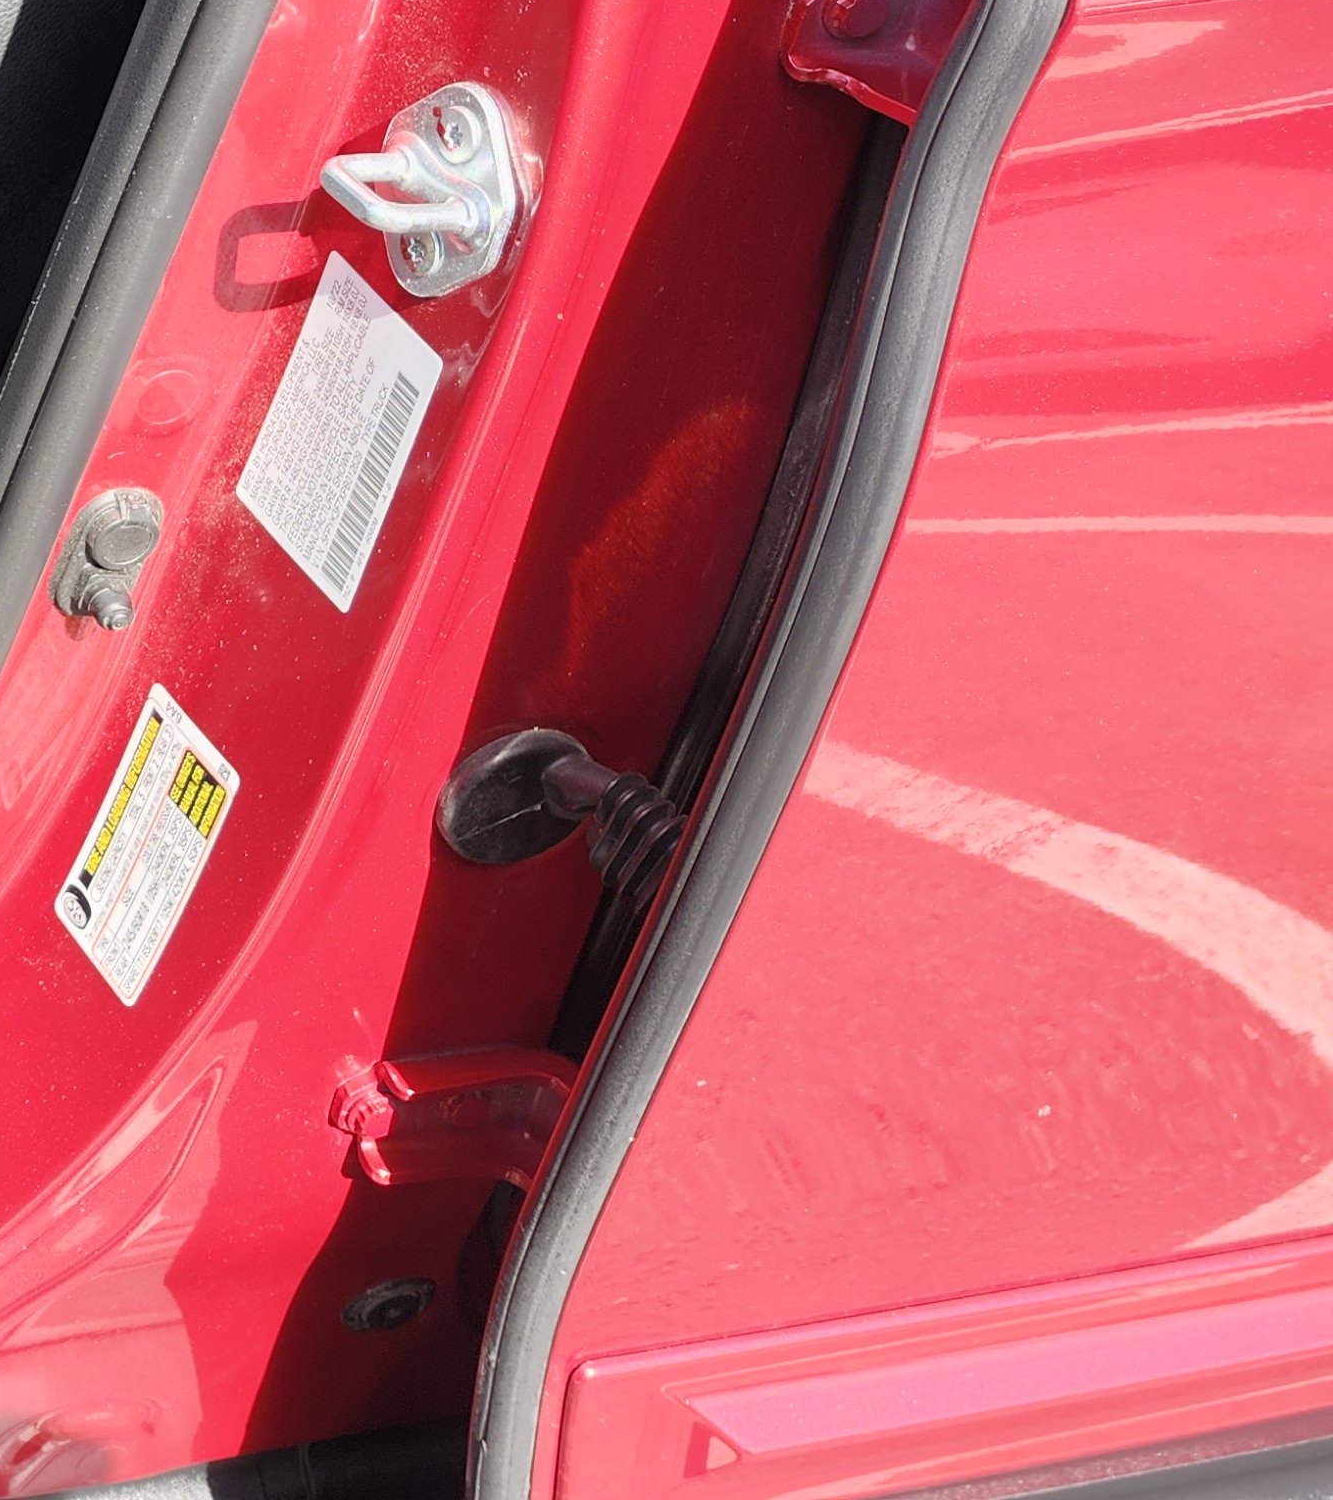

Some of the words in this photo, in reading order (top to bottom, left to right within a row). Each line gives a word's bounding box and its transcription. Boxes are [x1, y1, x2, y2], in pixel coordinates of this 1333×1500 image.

[320, 325, 335, 353] SIZE
[248, 417, 287, 503] MANUFACTURING
[307, 336, 320, 360] LLC
[257, 415, 277, 455] HONDA
[271, 345, 306, 421] DEVELOPMENT
[279, 508, 294, 536] THIS
[288, 465, 311, 512] VEHICLE
[305, 408, 334, 470] CONFORMS
[334, 373, 348, 397] ALL
[341, 311, 372, 378] APPLICABLE
[370, 380, 389, 420] TRUCK
[256, 474, 274, 510] GVWR
[263, 483, 281, 519] GAWR
[271, 491, 289, 527] GAWR
[286, 495, 310, 545] FEDERAL
[304, 458, 325, 500] MOTOR
[319, 414, 342, 463] VEHICLE
[336, 374, 358, 419] SAFETY
[294, 489, 323, 553] STANDARDS
[322, 438, 344, 482] EFFECT
[345, 399, 359, 426] THE
[353, 371, 370, 404] DATE
[302, 484, 337, 563] MANUFACTURE
[331, 445, 352, 489] SHOWN
[94, 824, 112, 855] AND
[104, 781, 131, 833] LOADING
[122, 714, 161, 791] INFORMATION
